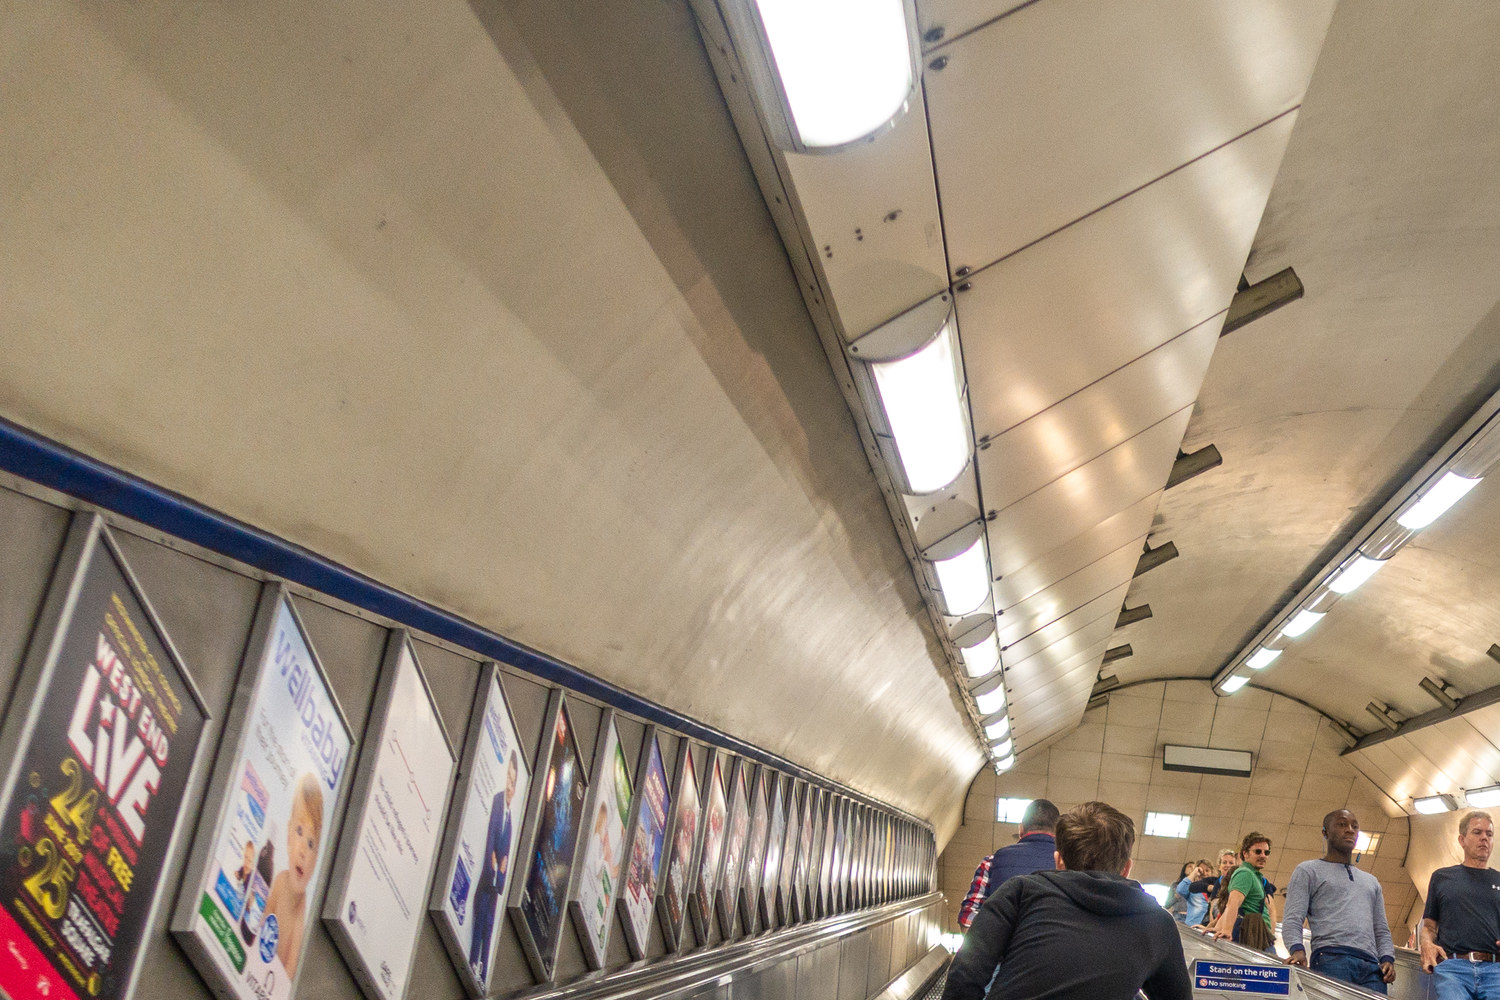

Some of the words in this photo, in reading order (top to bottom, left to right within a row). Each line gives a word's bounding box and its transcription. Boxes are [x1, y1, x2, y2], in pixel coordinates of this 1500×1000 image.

[97, 632, 142, 718] WEST
[138, 704, 168, 767] END
[51, 758, 98, 845] 24
[24, 838, 76, 919] 25
[107, 845, 134, 892] FREE
[60, 919, 96, 967] SQUARE
[1209, 965, 1231, 974] Stand
[1244, 968, 1258, 976] the
[1259, 969, 1278, 978] right
[1219, 981, 1247, 989] smoking
